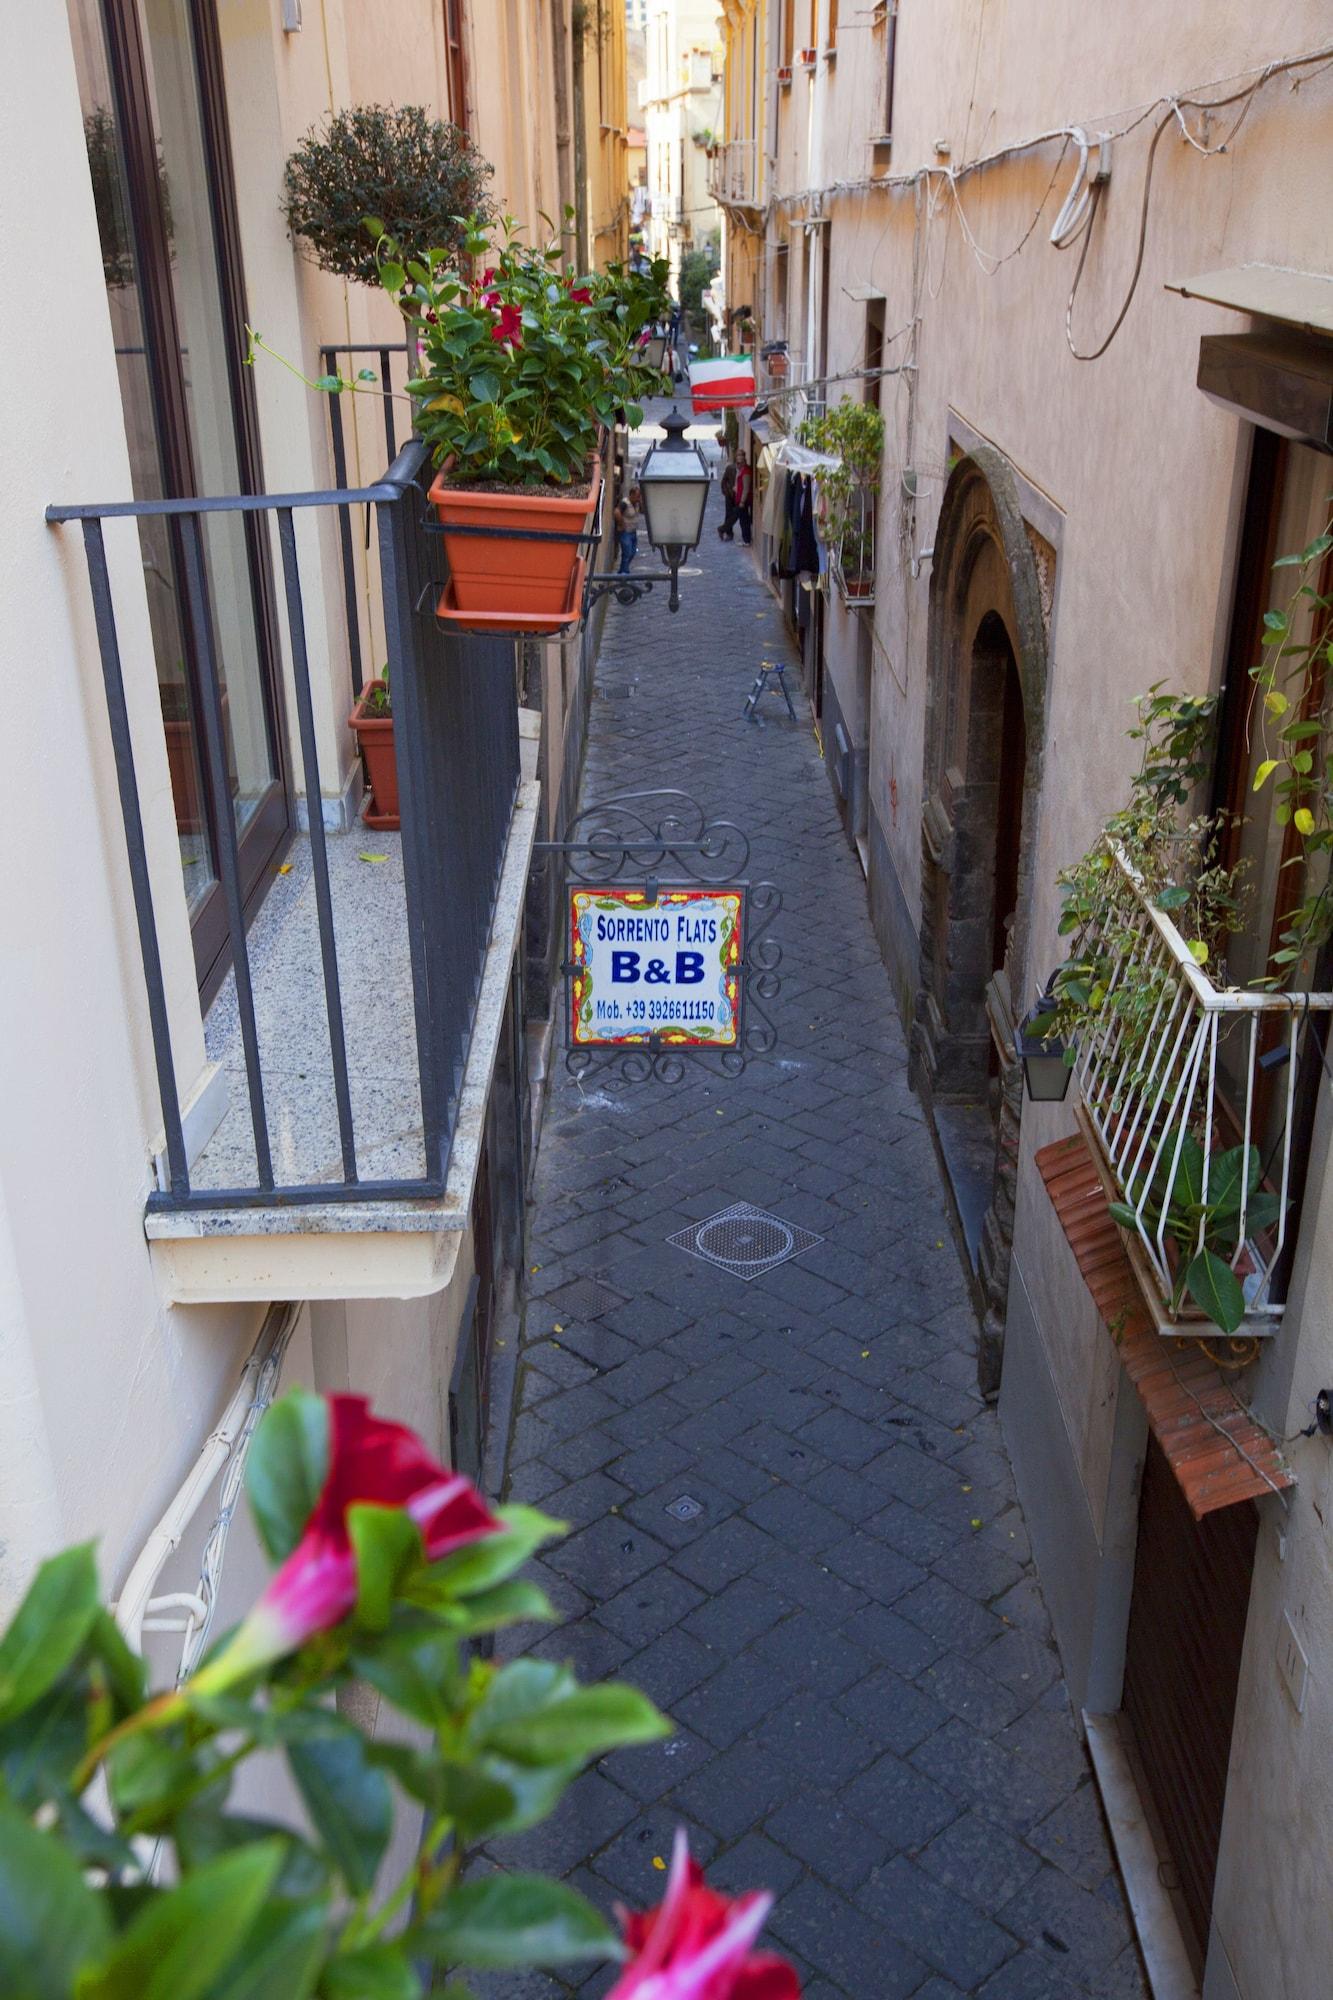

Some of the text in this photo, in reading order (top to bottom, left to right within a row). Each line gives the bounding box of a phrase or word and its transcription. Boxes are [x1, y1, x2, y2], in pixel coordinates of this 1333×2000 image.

[597, 914, 717, 943] SORRENTO FLATS
[612, 951, 705, 984] B&B
[597, 1000, 715, 1020] Mob. +39 3926611150
